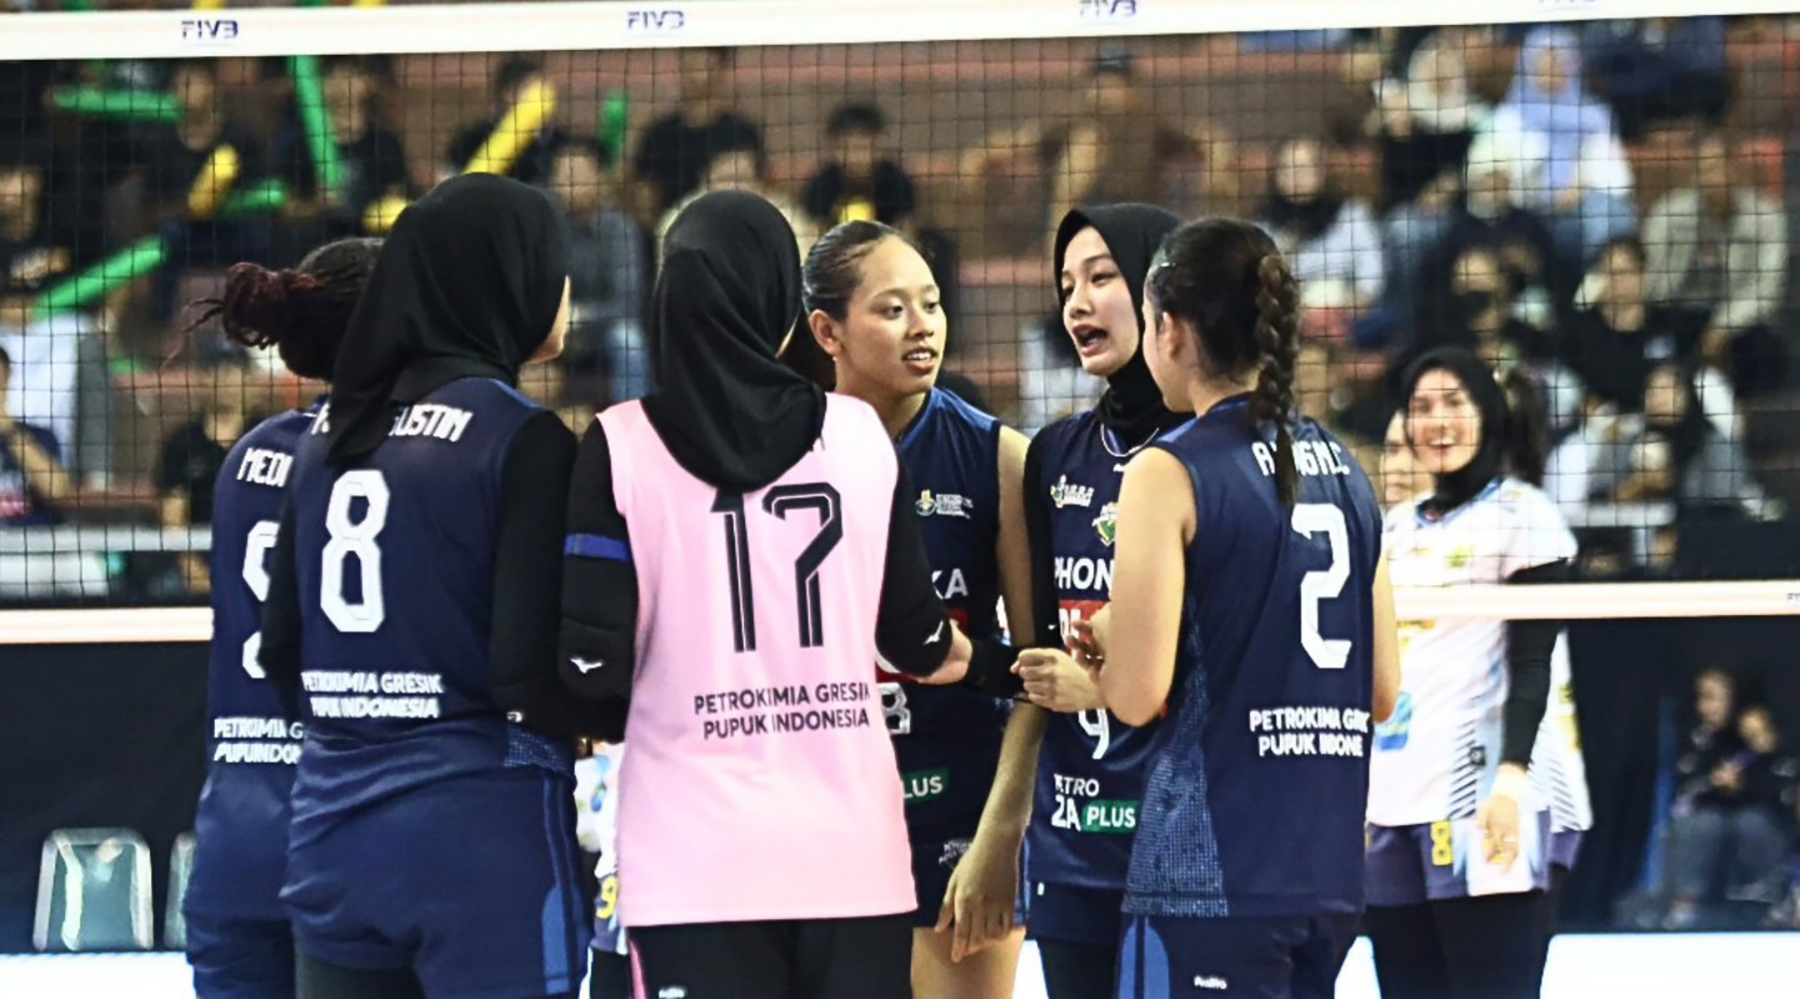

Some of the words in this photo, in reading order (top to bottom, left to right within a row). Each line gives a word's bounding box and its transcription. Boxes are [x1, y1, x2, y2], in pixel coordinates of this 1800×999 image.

[181, 20, 239, 39] FIVB
[237, 448, 293, 487] MEDI
[320, 470, 390, 632] 8
[710, 482, 843, 653] 17
[1291, 503, 1352, 668] 2
[694, 685, 810, 715] PETROKIMIA
[704, 711, 768, 740] PUPUK
[772, 708, 870, 732] INDONESIA
[1087, 806, 1136, 828] PLUS
[1431, 820, 1454, 865] 8
